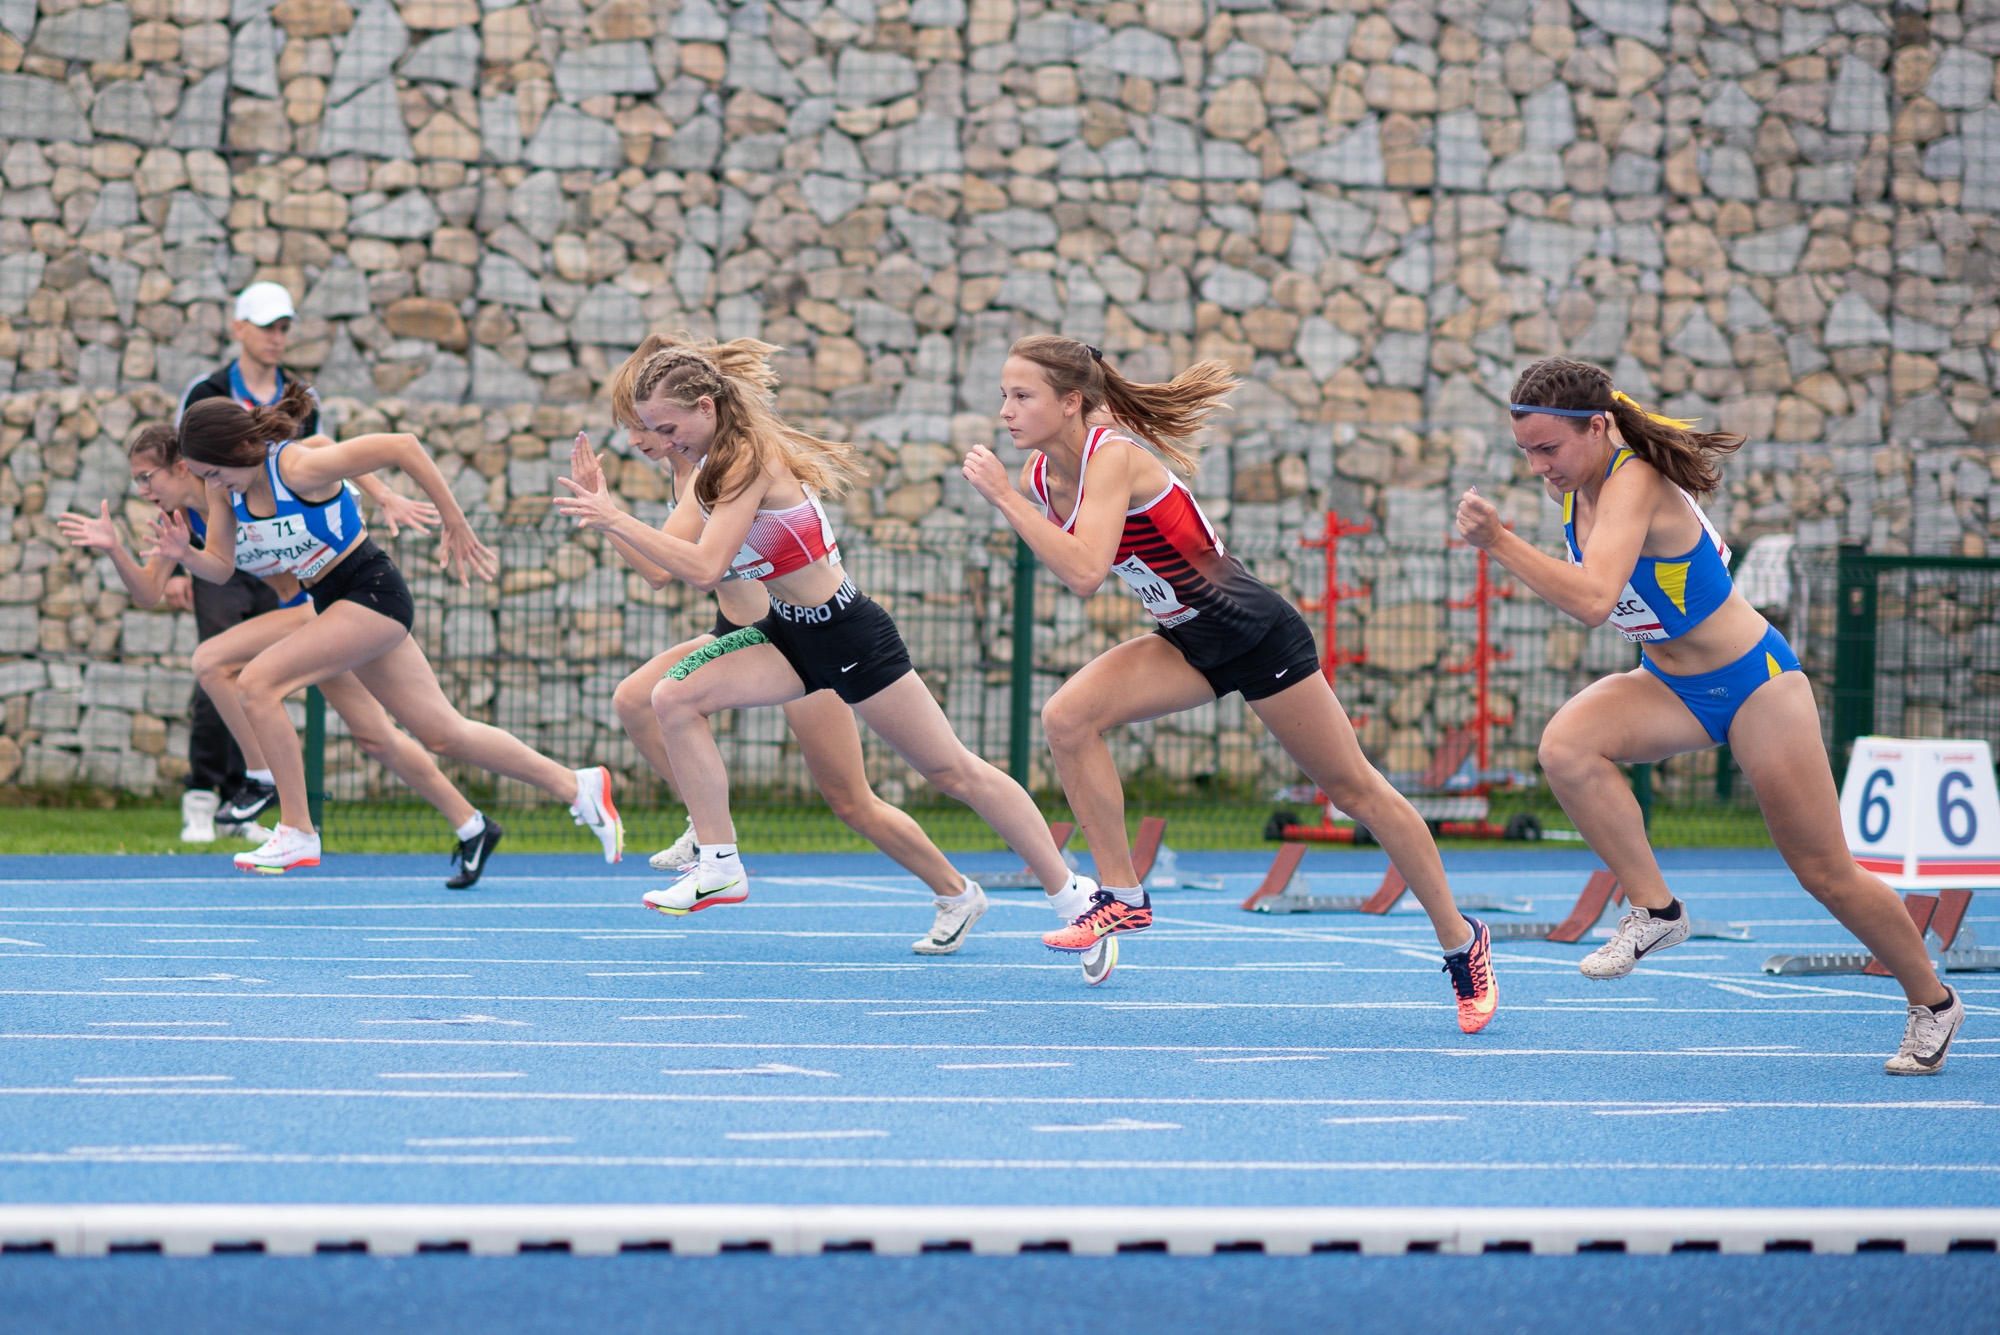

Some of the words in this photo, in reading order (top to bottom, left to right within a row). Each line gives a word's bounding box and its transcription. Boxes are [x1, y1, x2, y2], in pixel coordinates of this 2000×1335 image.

[272, 520, 296, 537] 71
[307, 558, 325, 576] 2021
[747, 567, 765, 579] 2021
[794, 604, 832, 624] PRO
[1632, 632, 1655, 641] 2021
[1859, 769, 1894, 843] 6
[1938, 771, 1977, 846] 6
